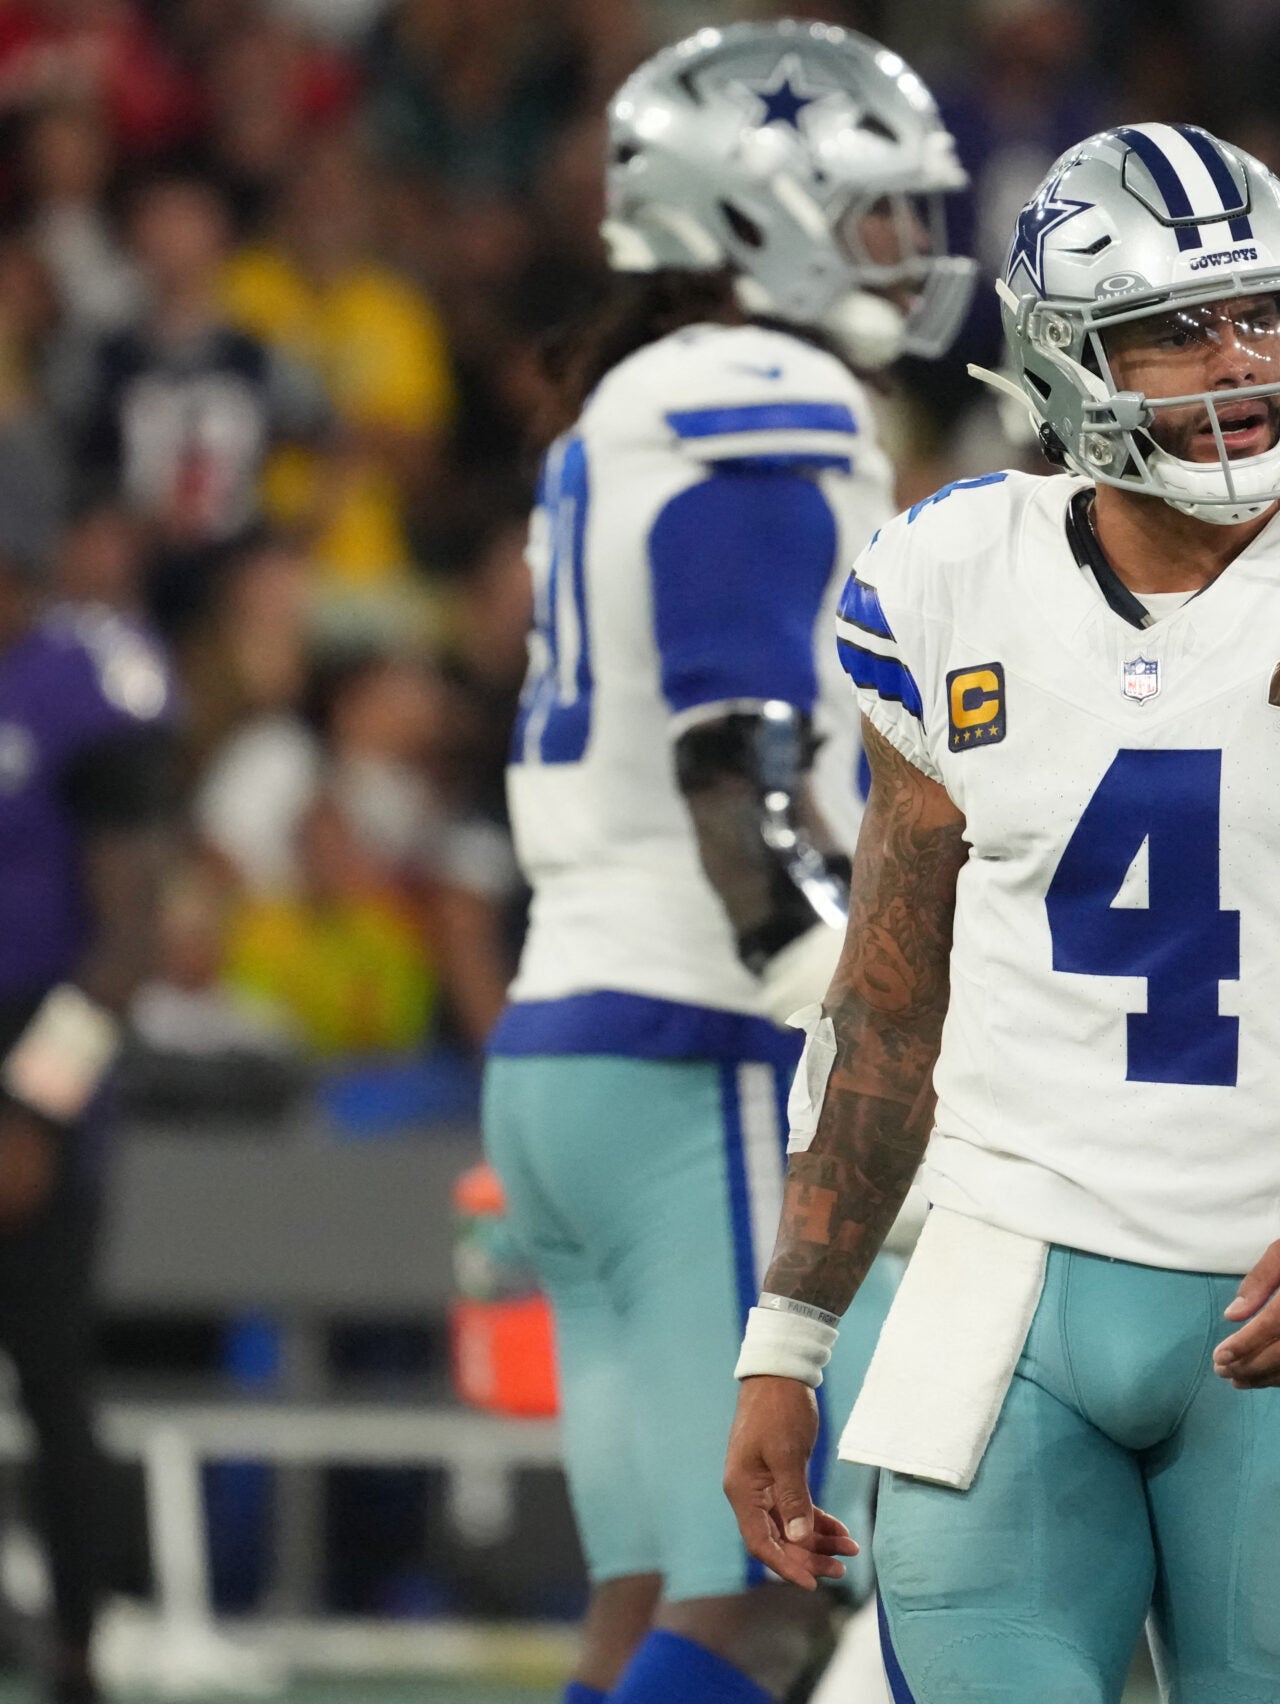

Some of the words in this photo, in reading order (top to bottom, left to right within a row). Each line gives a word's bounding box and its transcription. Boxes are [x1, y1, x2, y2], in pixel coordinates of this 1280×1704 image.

[1189, 247, 1258, 270] COWBOYS
[951, 670, 999, 729] C
[1045, 748, 1240, 1087] 4
[787, 1301, 814, 1316] FAITH
